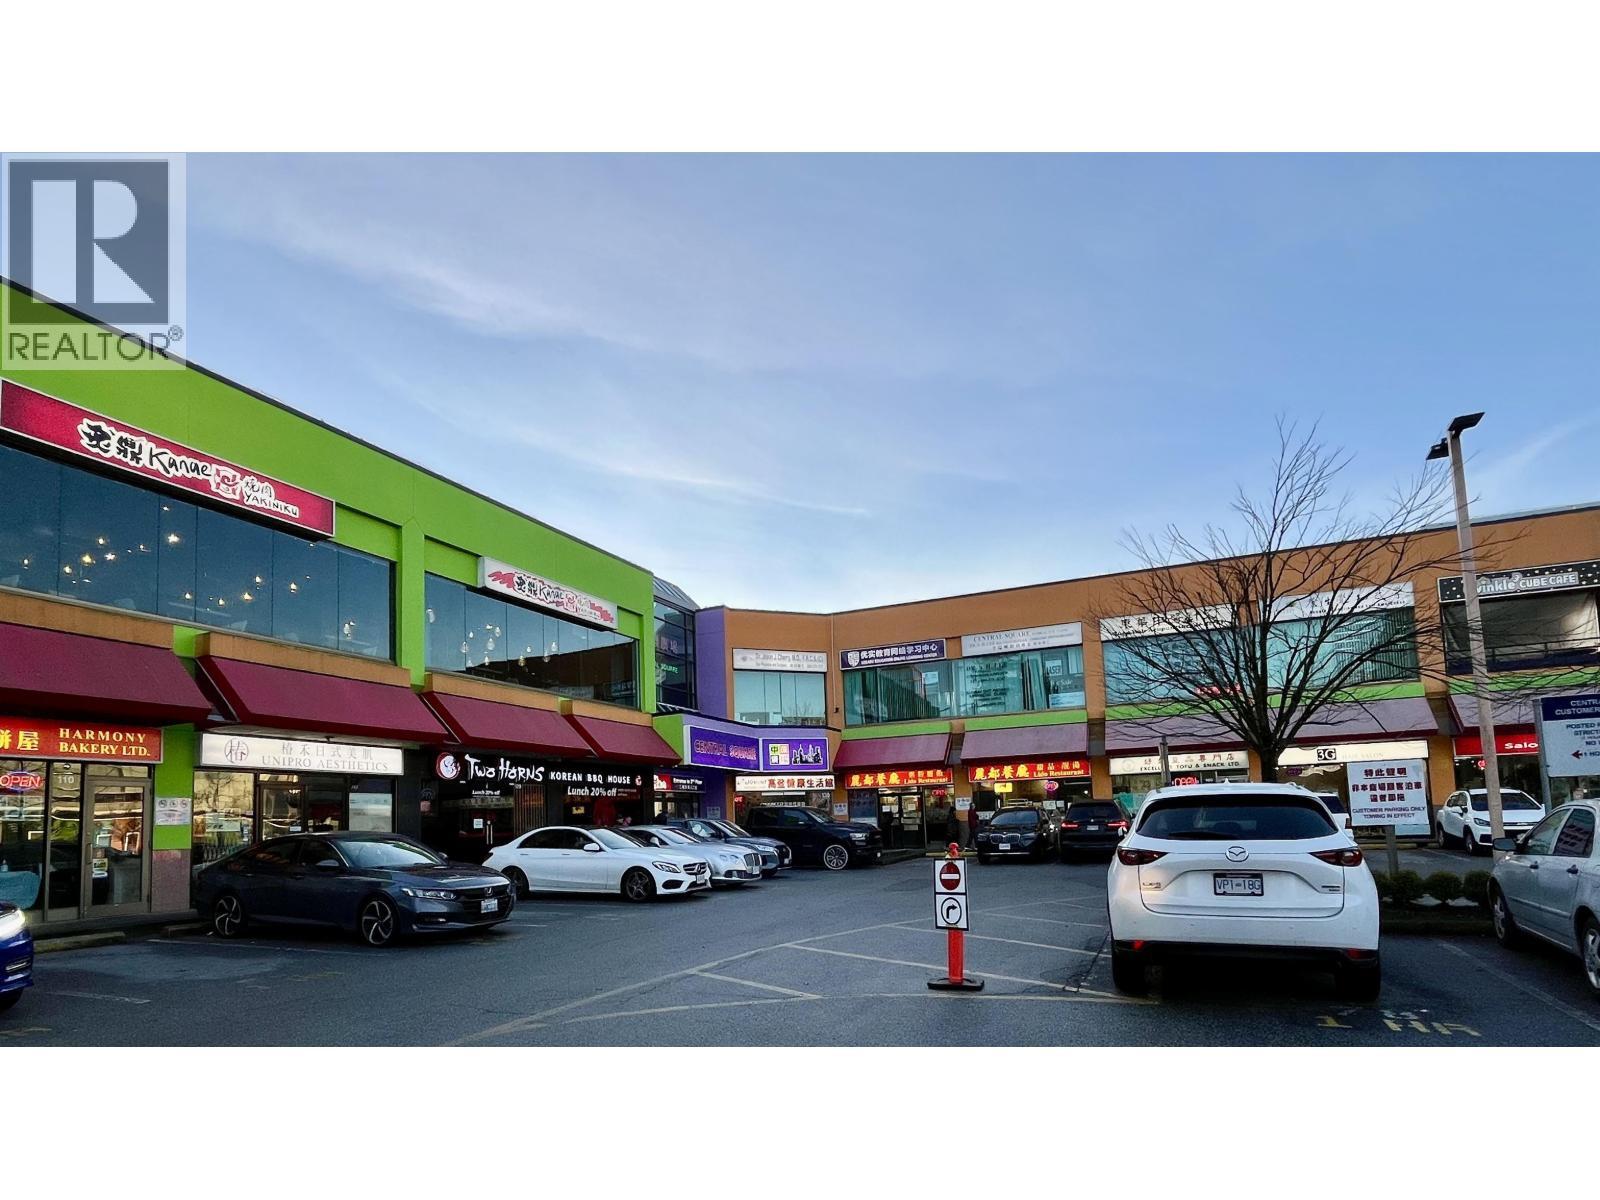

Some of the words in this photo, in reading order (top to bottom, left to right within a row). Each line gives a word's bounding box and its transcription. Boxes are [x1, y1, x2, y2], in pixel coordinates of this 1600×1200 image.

[149, 446, 212, 476] Kanae
[245, 492, 299, 518] YAKINIKU
[1519, 577, 1548, 589] CUBE
[1549, 574, 1577, 585] CAFE
[973, 632, 1003, 642] CENTRAL
[59, 728, 146, 743] HARMONY
[59, 741, 119, 755] BAKERY
[122, 746, 151, 756] LTD.
[1504, 742, 1538, 750] Salo
[1318, 749, 1336, 760] 3G
[261, 755, 312, 768] UNIPRO
[317, 757, 388, 772] AESTHETICS
[58, 775, 75, 784] 110
[550, 771, 583, 782] KOREAN
[587, 772, 603, 784] BBQ
[607, 773, 631, 784] HOUSE
[1050, 769, 1085, 777] Restaurant
[0, 775, 41, 788] OPEN
[567, 785, 589, 796] Lunch
[590, 786, 607, 797] 20%
[607, 787, 617, 797] off
